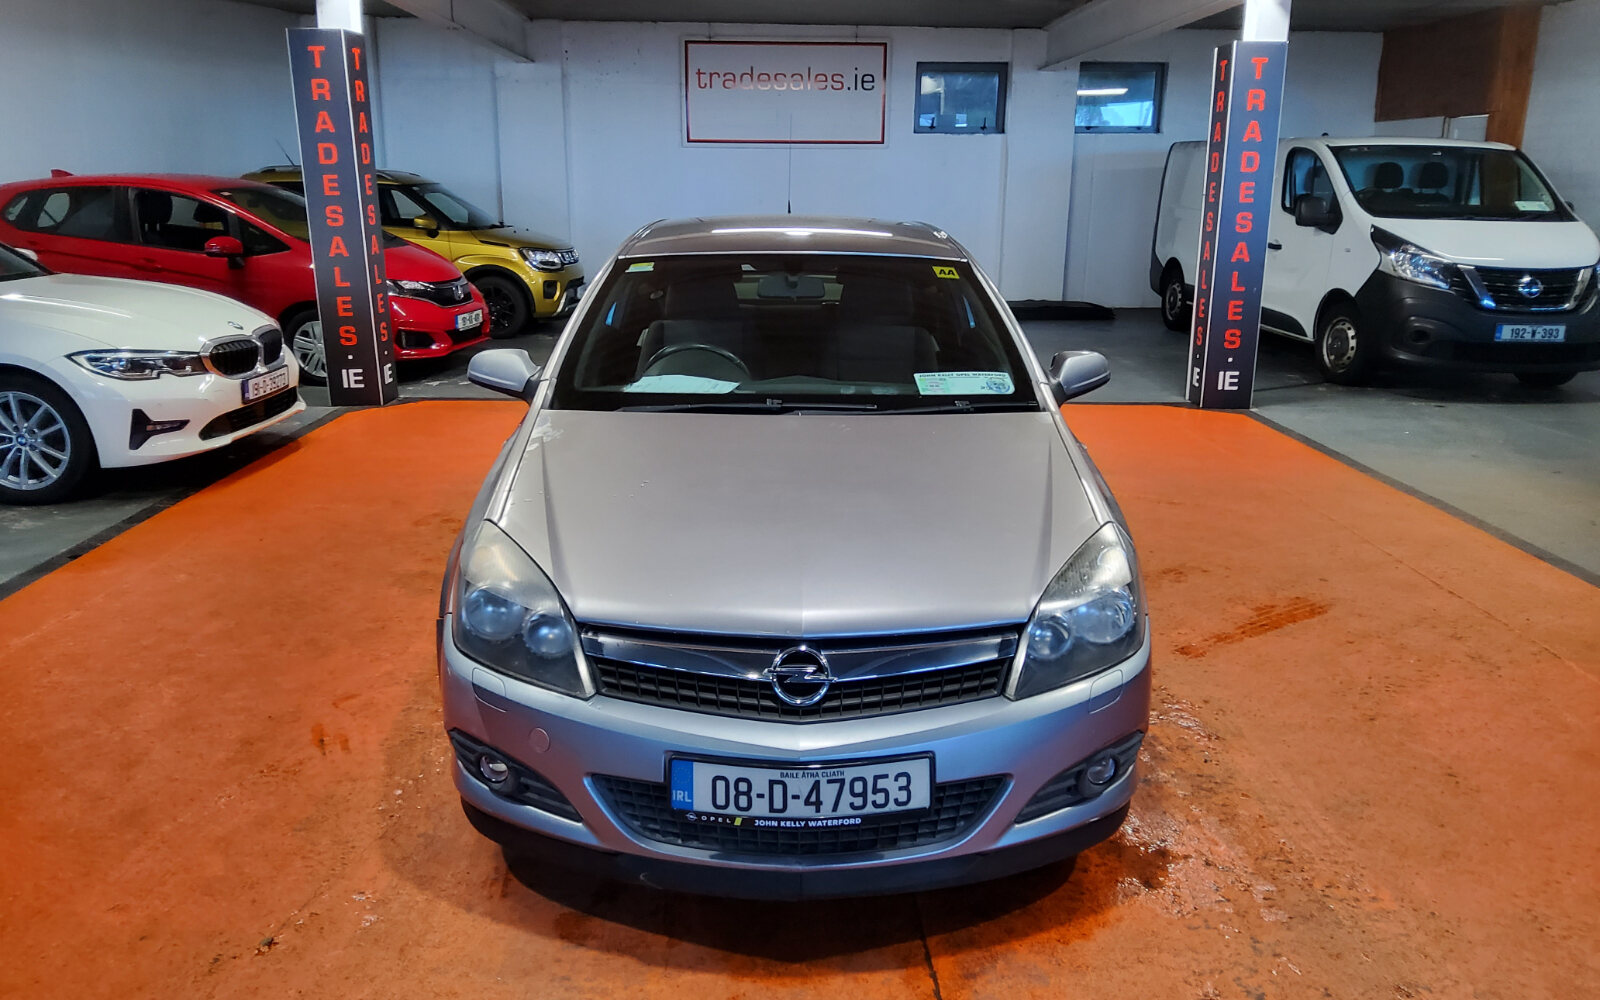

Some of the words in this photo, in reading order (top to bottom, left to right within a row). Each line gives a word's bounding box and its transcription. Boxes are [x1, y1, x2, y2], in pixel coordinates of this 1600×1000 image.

[695, 66, 875, 91] tradesales.ie
[1510, 327, 1560, 339] 192-W-393
[779, 771, 799, 779] BAILE
[821, 770, 845, 778] CLIATH
[672, 789, 692, 803] IRL
[711, 771, 912, 814] 08-D-47953
[701, 815, 732, 824] OPEL
[754, 819, 778, 827] JOHN
[807, 818, 862, 827] WATERFORD
